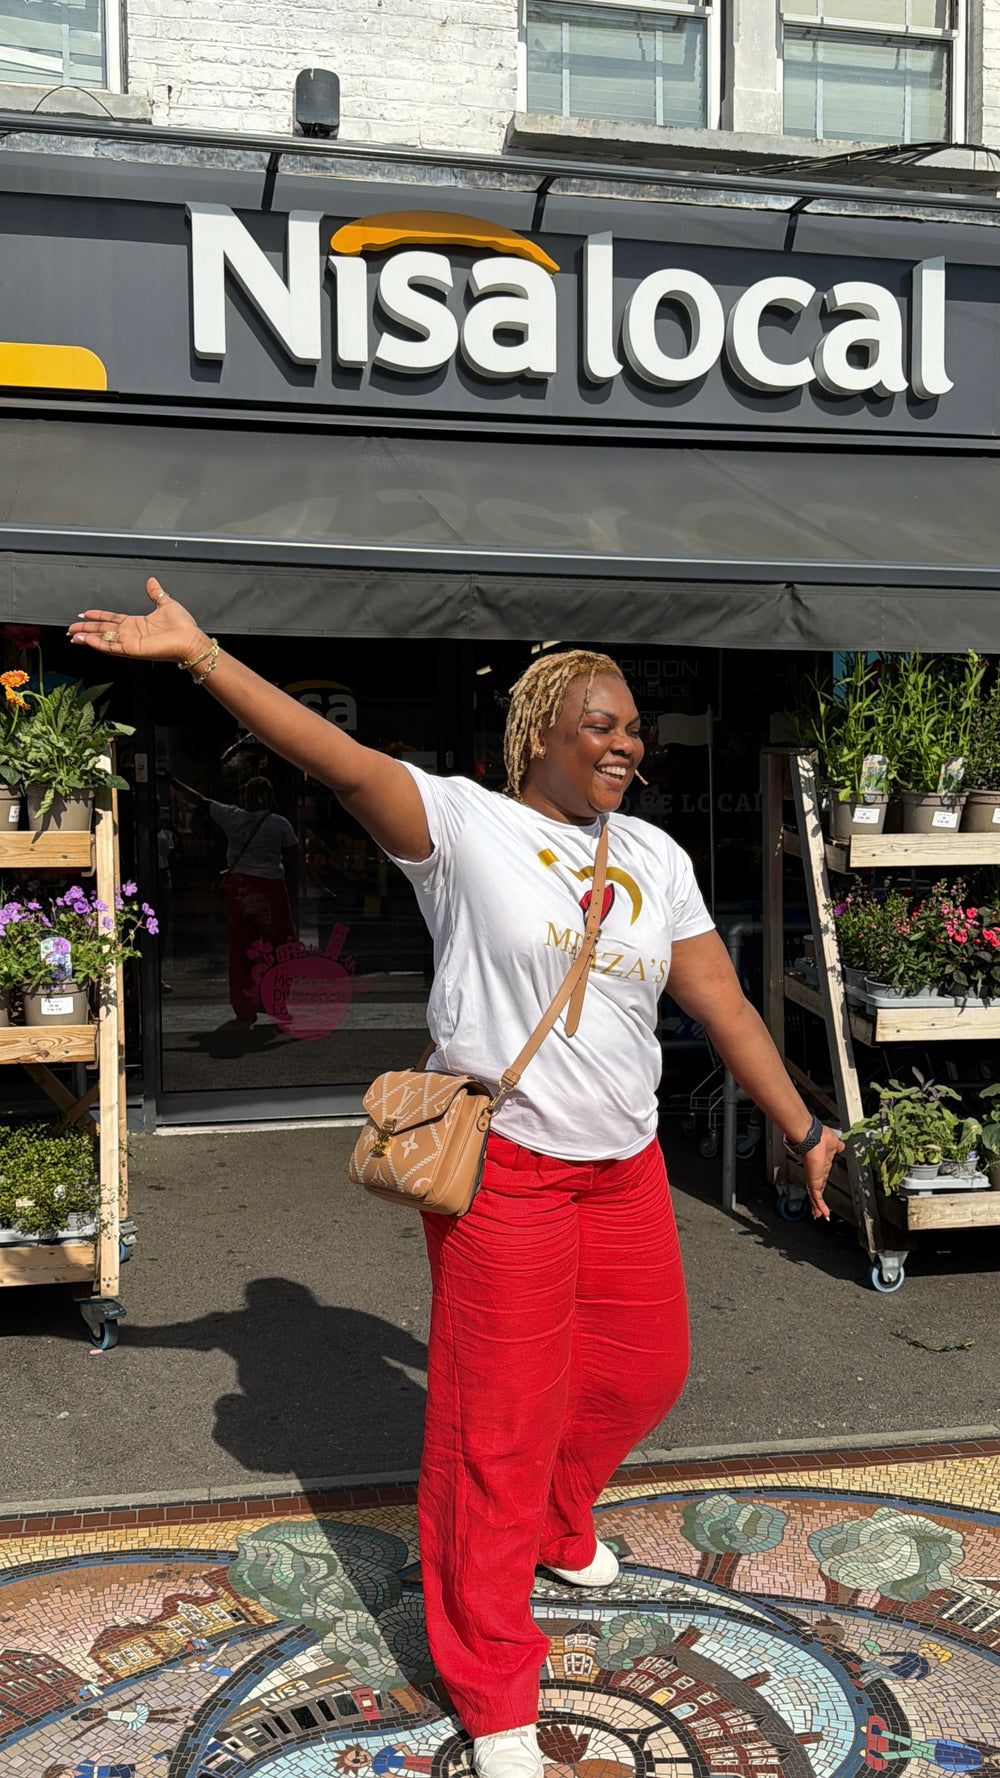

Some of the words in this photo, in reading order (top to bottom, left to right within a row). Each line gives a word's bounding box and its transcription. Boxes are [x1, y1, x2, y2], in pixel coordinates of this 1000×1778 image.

[185, 202, 557, 380] Nisa
[582, 230, 954, 399] local
[632, 684, 691, 697] NIENCE
